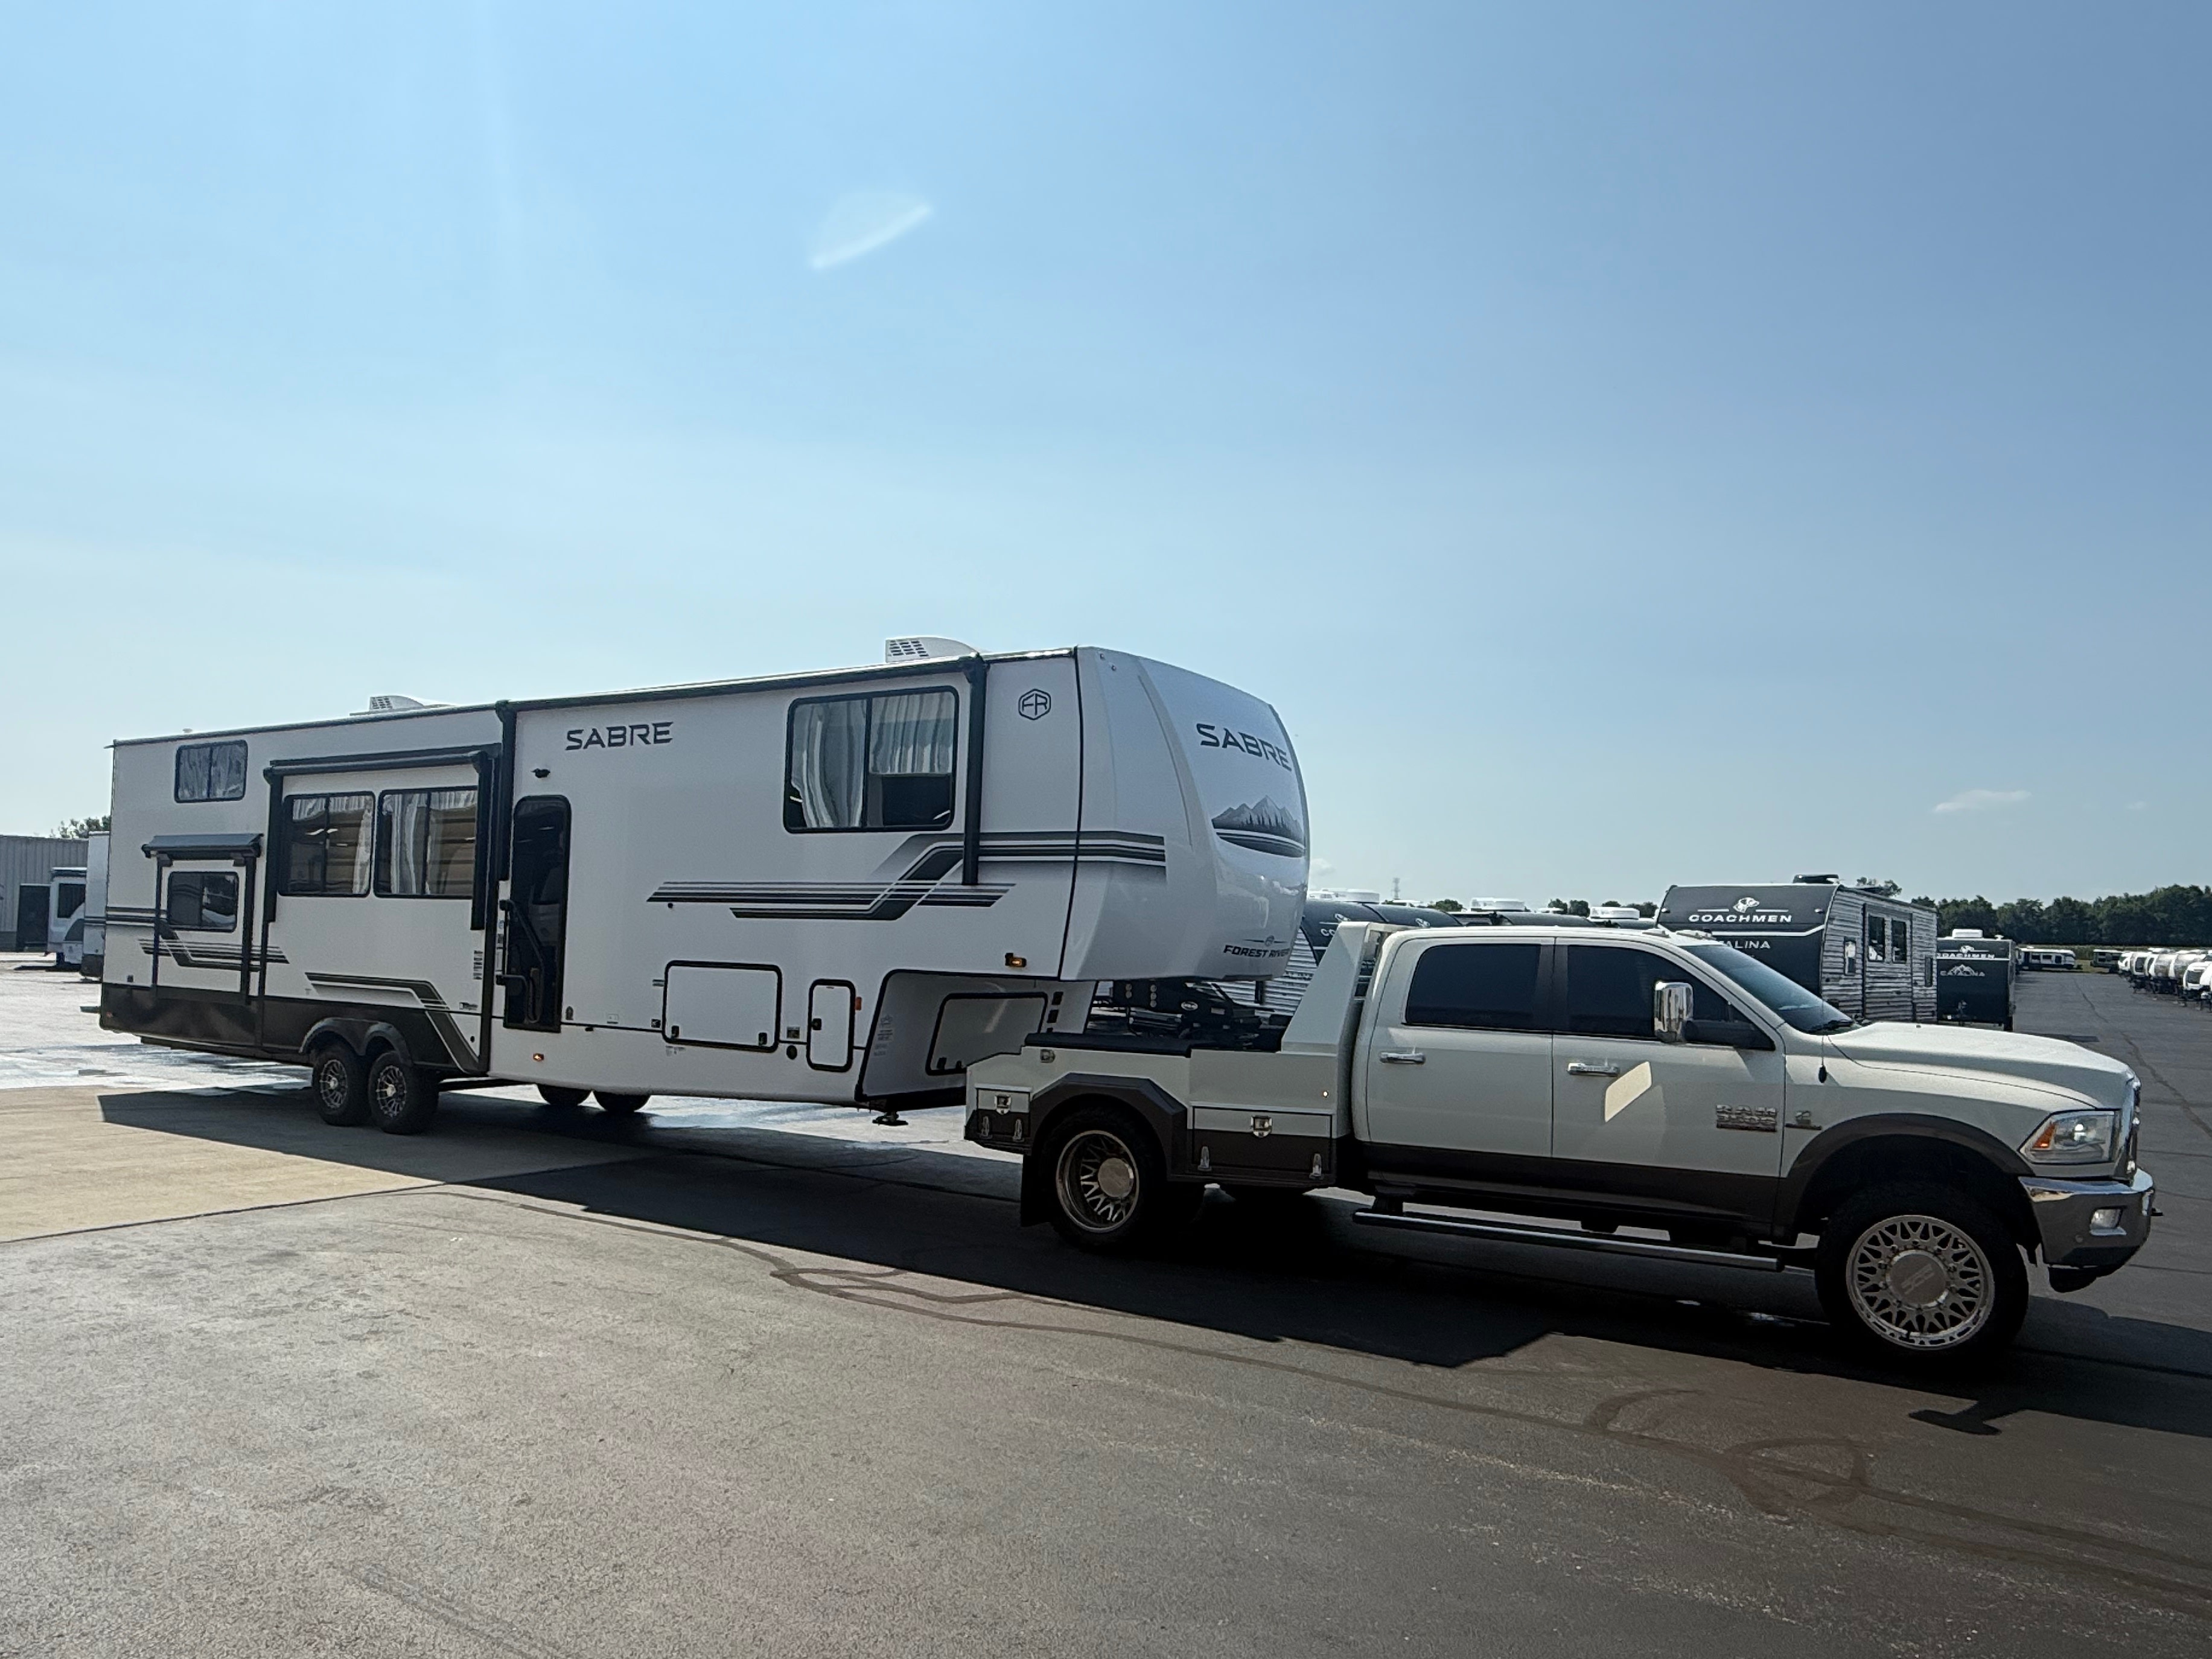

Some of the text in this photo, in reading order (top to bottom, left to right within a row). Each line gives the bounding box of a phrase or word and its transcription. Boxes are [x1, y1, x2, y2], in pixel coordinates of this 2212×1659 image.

[564, 722, 674, 751] SABRE
[1196, 723, 1292, 772] SABRE
[1688, 914, 1793, 923] COACHMEN
[1223, 944, 1269, 958] FOREST
